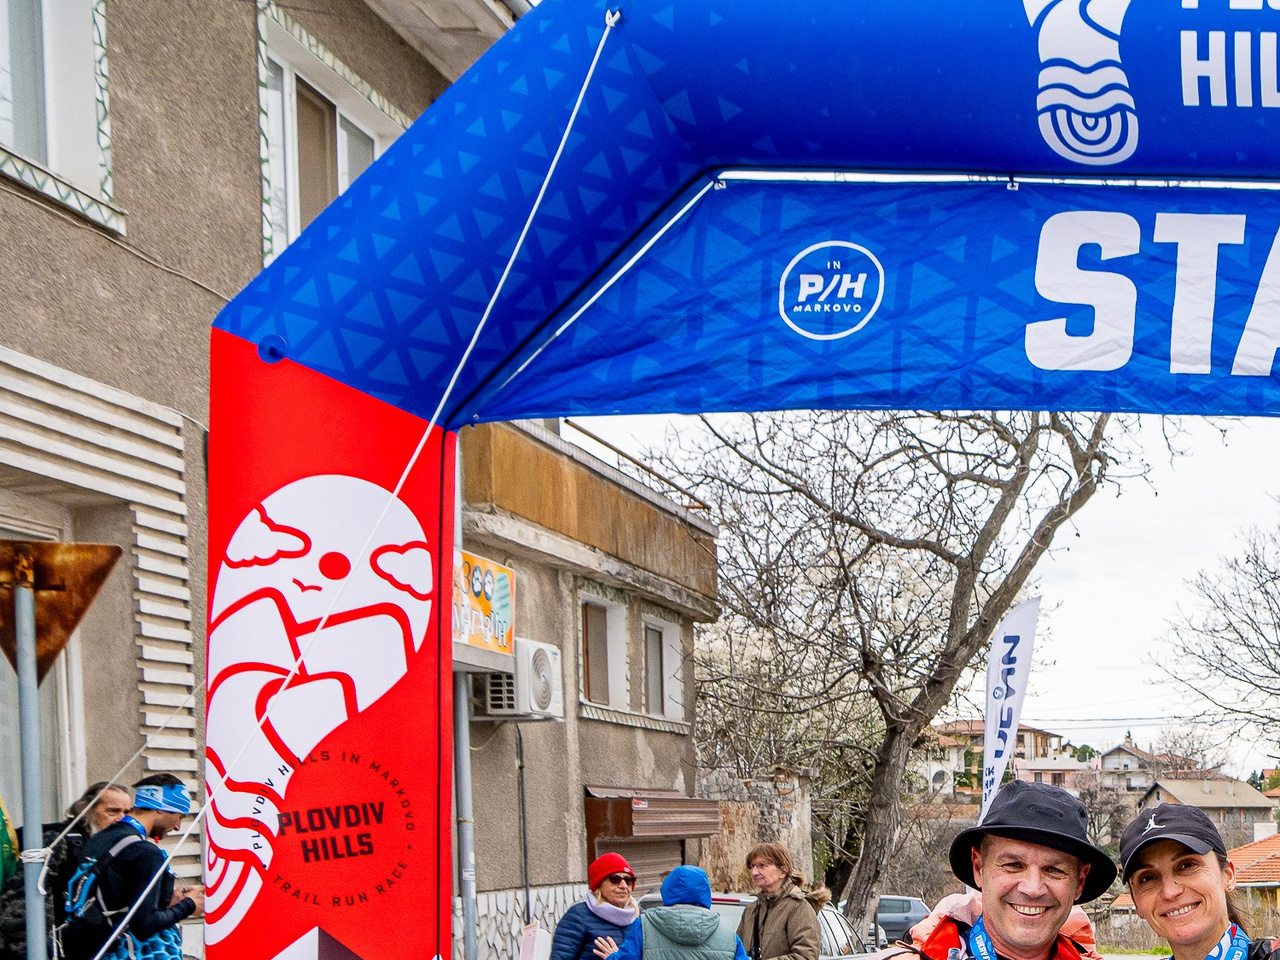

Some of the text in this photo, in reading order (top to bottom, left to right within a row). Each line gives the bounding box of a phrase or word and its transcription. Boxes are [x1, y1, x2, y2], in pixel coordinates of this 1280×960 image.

[827, 261, 841, 269] IN
[797, 273, 867, 302] P/H
[793, 303, 862, 313] MARKOVO
[278, 751, 330, 776] HILLS
[342, 752, 360, 764] IN
[369, 761, 415, 831] MARKOVO
[277, 801, 385, 836] PLOVDIV
[301, 833, 375, 863] HILLS
[272, 860, 408, 907] TRAIL RUN RACE
